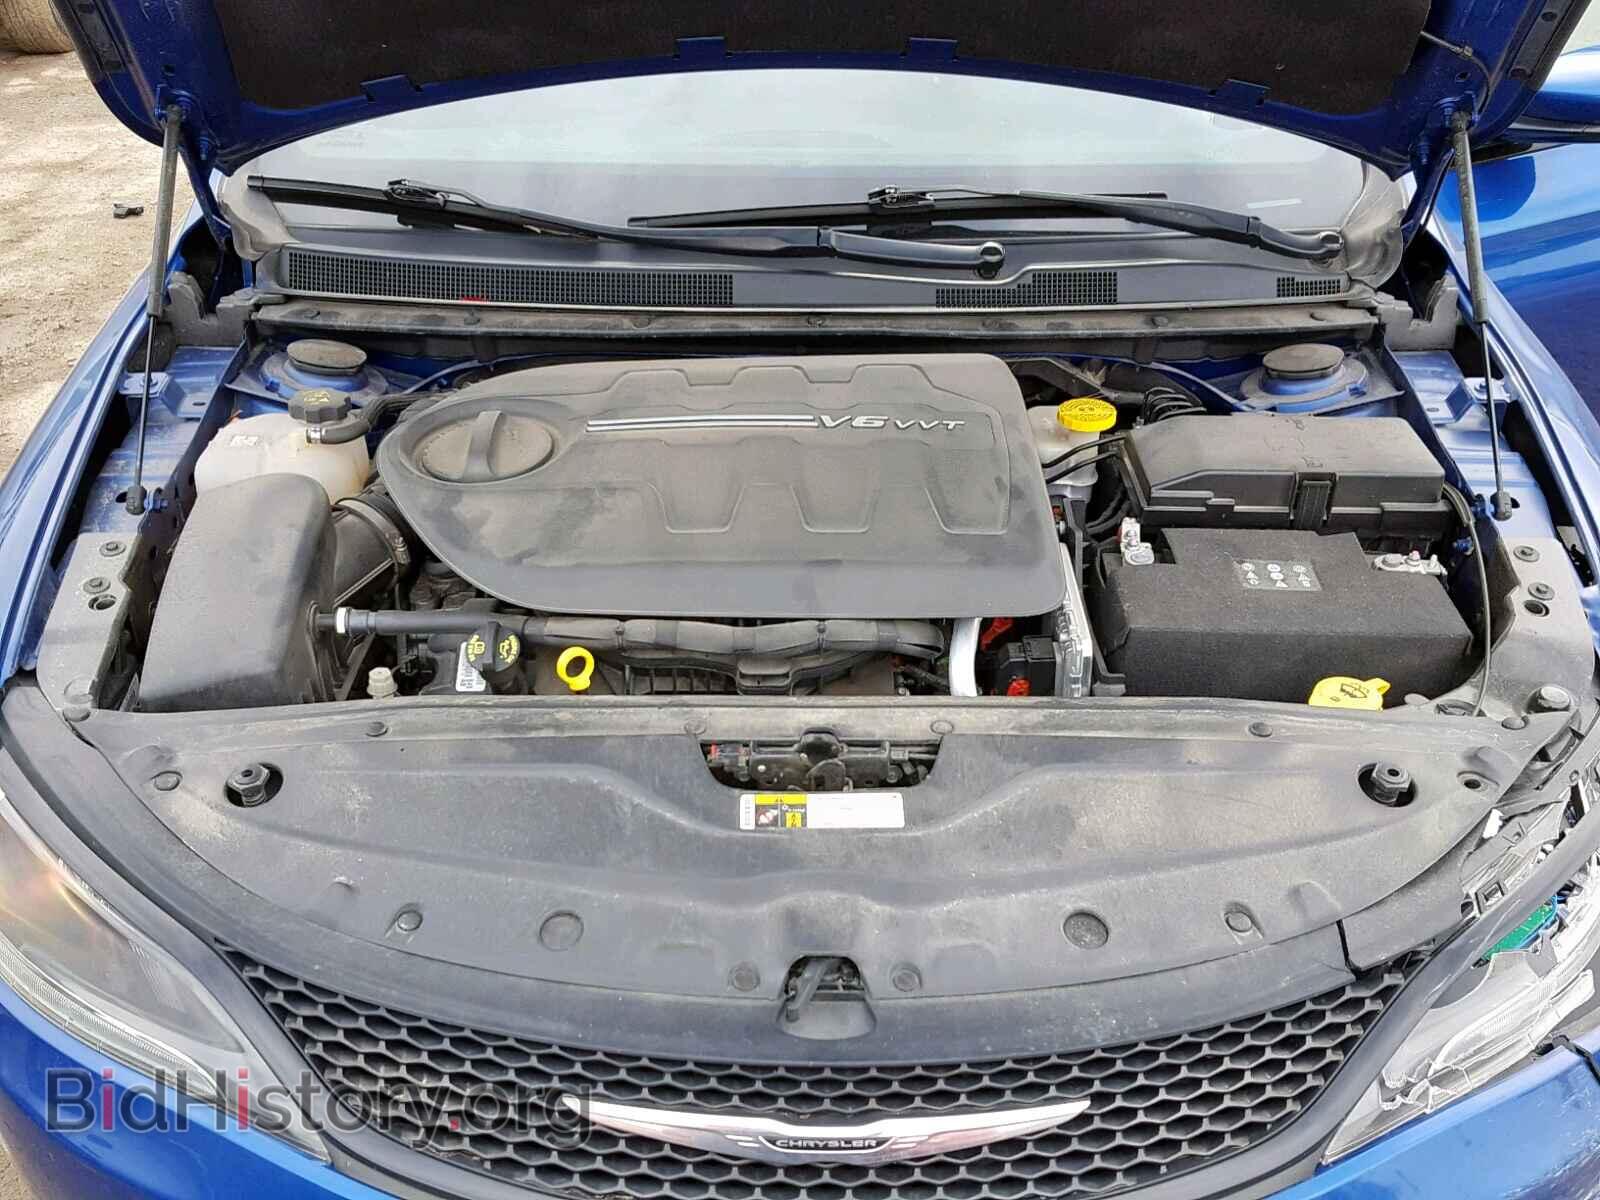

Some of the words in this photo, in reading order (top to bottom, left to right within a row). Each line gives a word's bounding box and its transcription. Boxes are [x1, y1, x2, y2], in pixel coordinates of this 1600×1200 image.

[819, 414, 889, 429] V6
[894, 419, 966, 430] VVT
[775, 1138, 878, 1150] CHRYSLER
